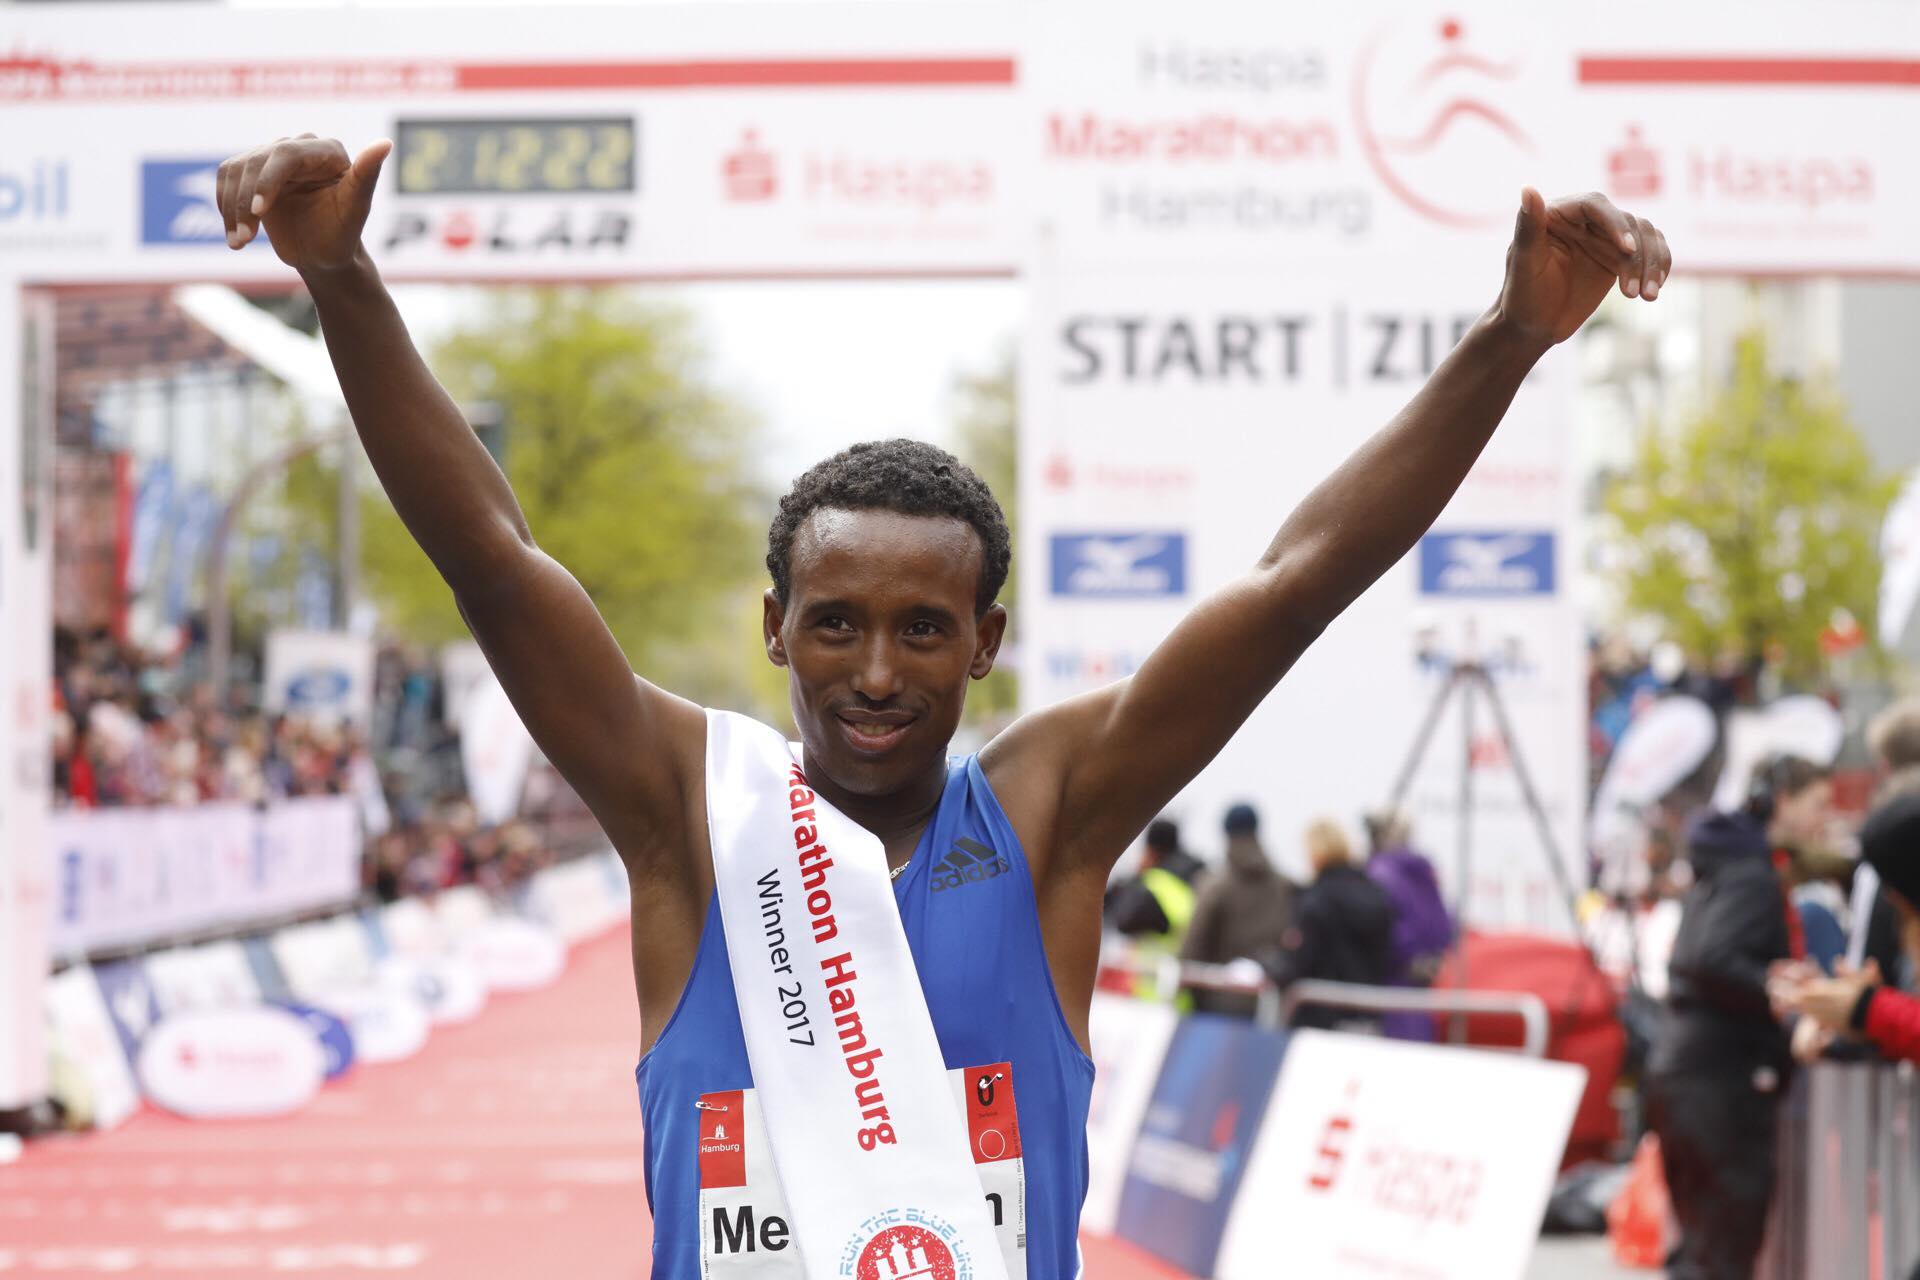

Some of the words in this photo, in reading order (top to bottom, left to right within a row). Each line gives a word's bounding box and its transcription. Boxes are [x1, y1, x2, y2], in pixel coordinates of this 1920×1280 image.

[1139, 45, 1326, 94] Haspa
[1047, 113, 1337, 160] Marathon
[384, 211, 632, 250] POLAR
[1100, 182, 1370, 239] Hamburg
[1061, 314, 1311, 382] START
[930, 857, 1009, 892] adidas
[757, 868, 793, 974] Winner
[778, 981, 815, 1047] 2017
[820, 951, 897, 1152] Hamburg
[701, 1143, 740, 1153] Hamburg
[840, 1233, 864, 1276] RUN
[906, 1208, 957, 1240] BLUE
